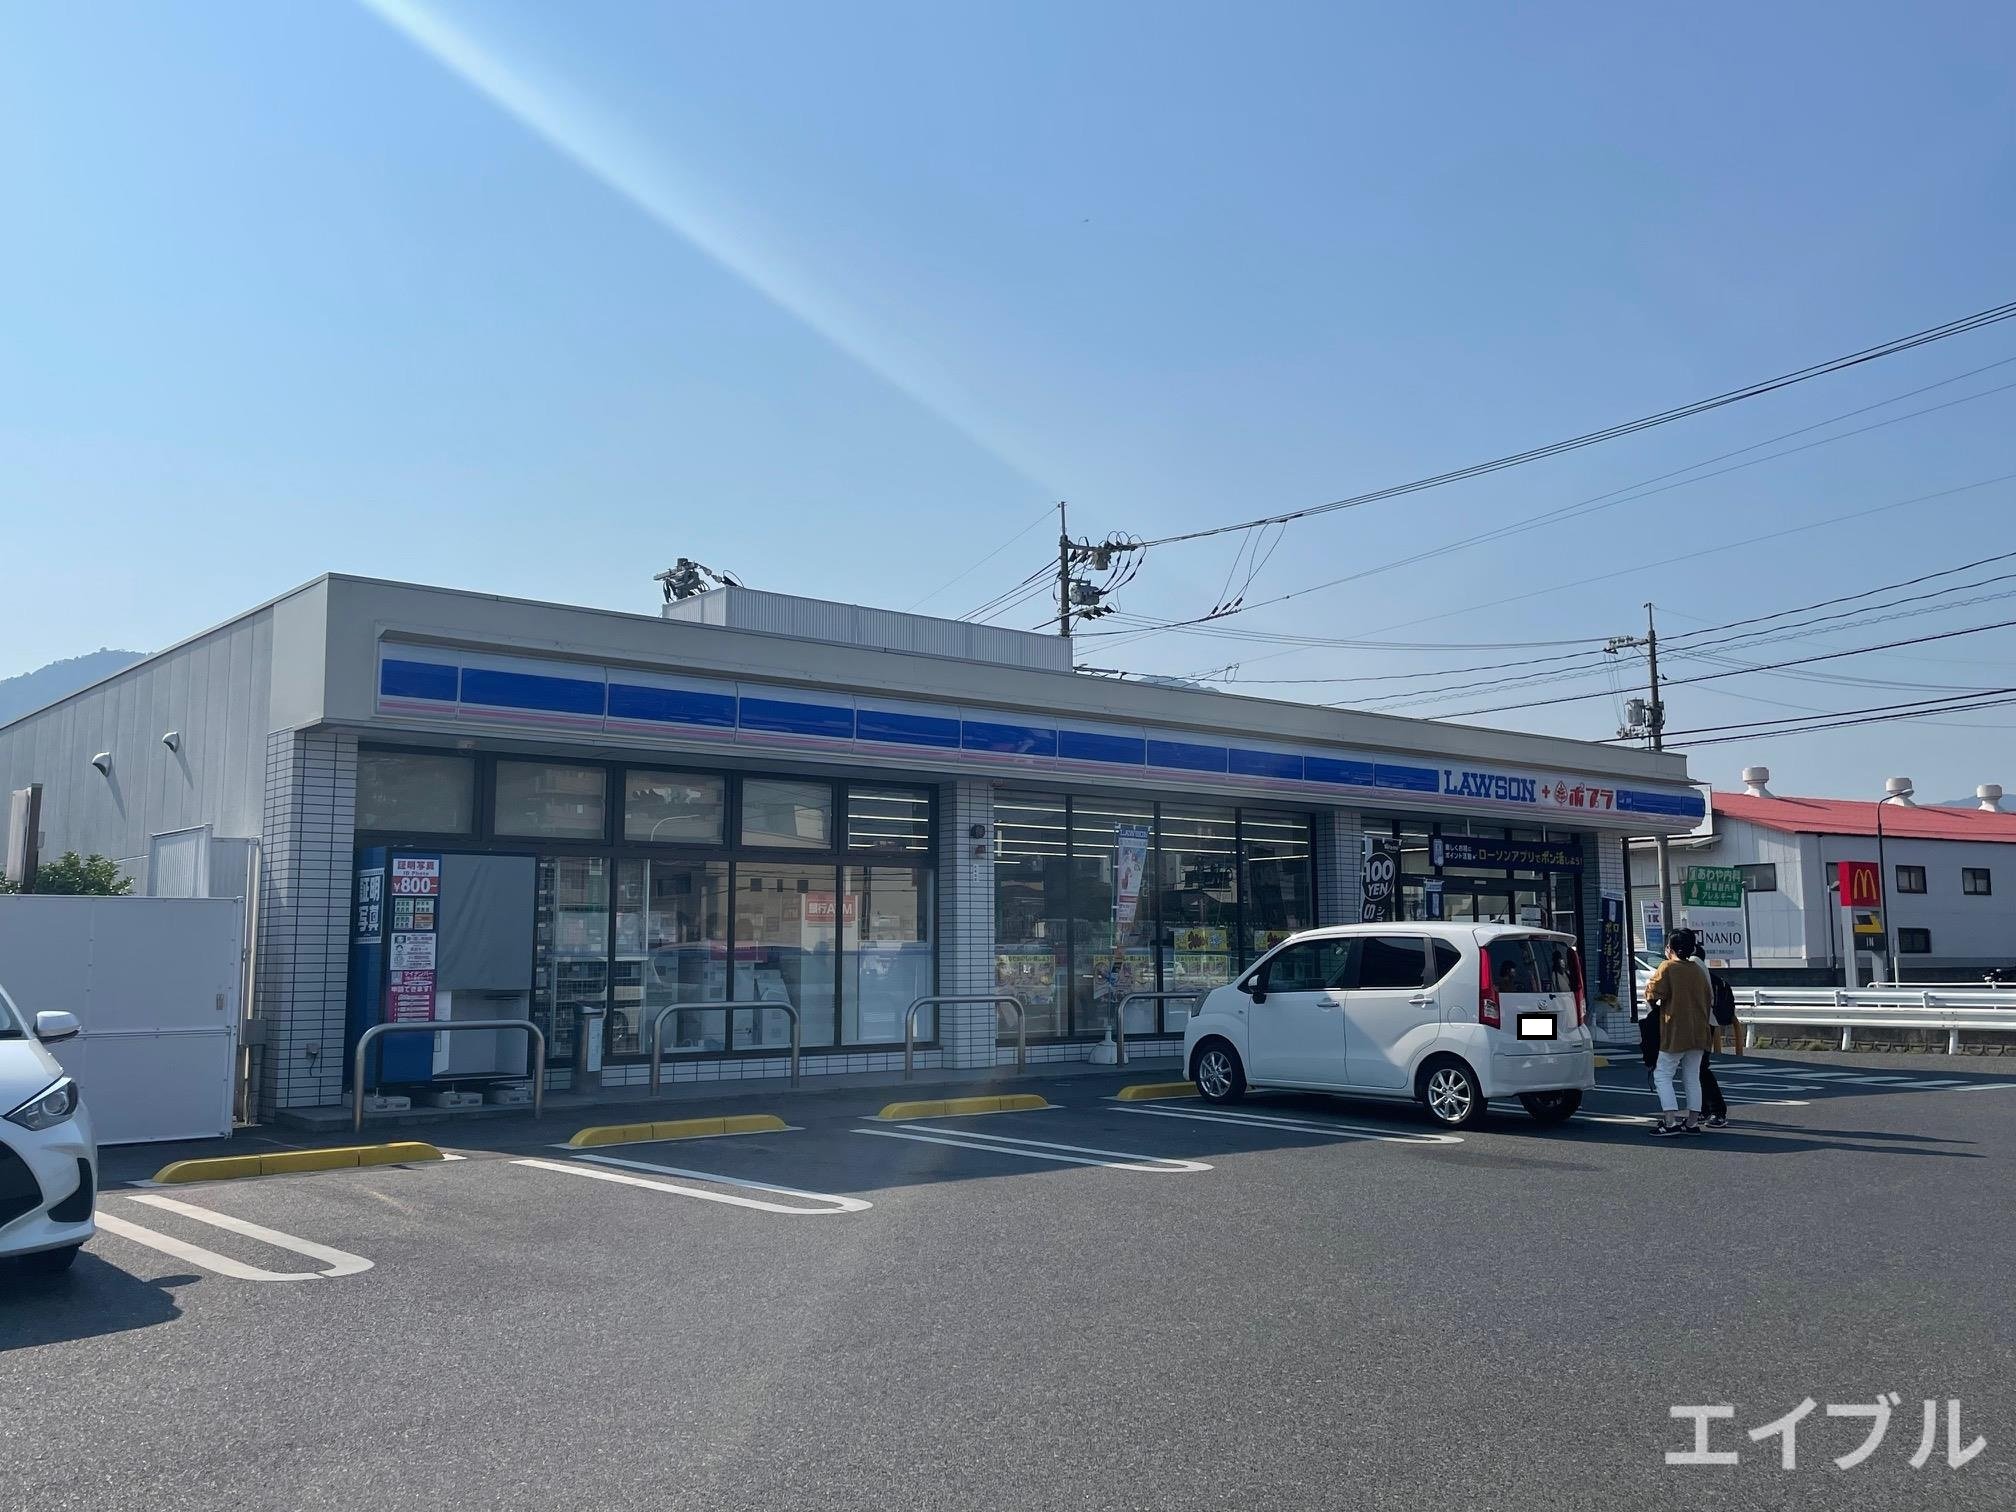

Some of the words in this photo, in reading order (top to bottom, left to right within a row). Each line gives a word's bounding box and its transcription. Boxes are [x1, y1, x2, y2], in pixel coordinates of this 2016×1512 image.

[1444, 769, 1537, 803] LAWSON
[1569, 781, 1614, 809] ポプラ
[1365, 860, 1393, 882] 100
[359, 876, 381, 902] 証明
[1368, 882, 1388, 897] YEN
[358, 904, 379, 931] 写真
[808, 902, 853, 914] 銀行AM
[1705, 932, 1742, 946] NANJO
